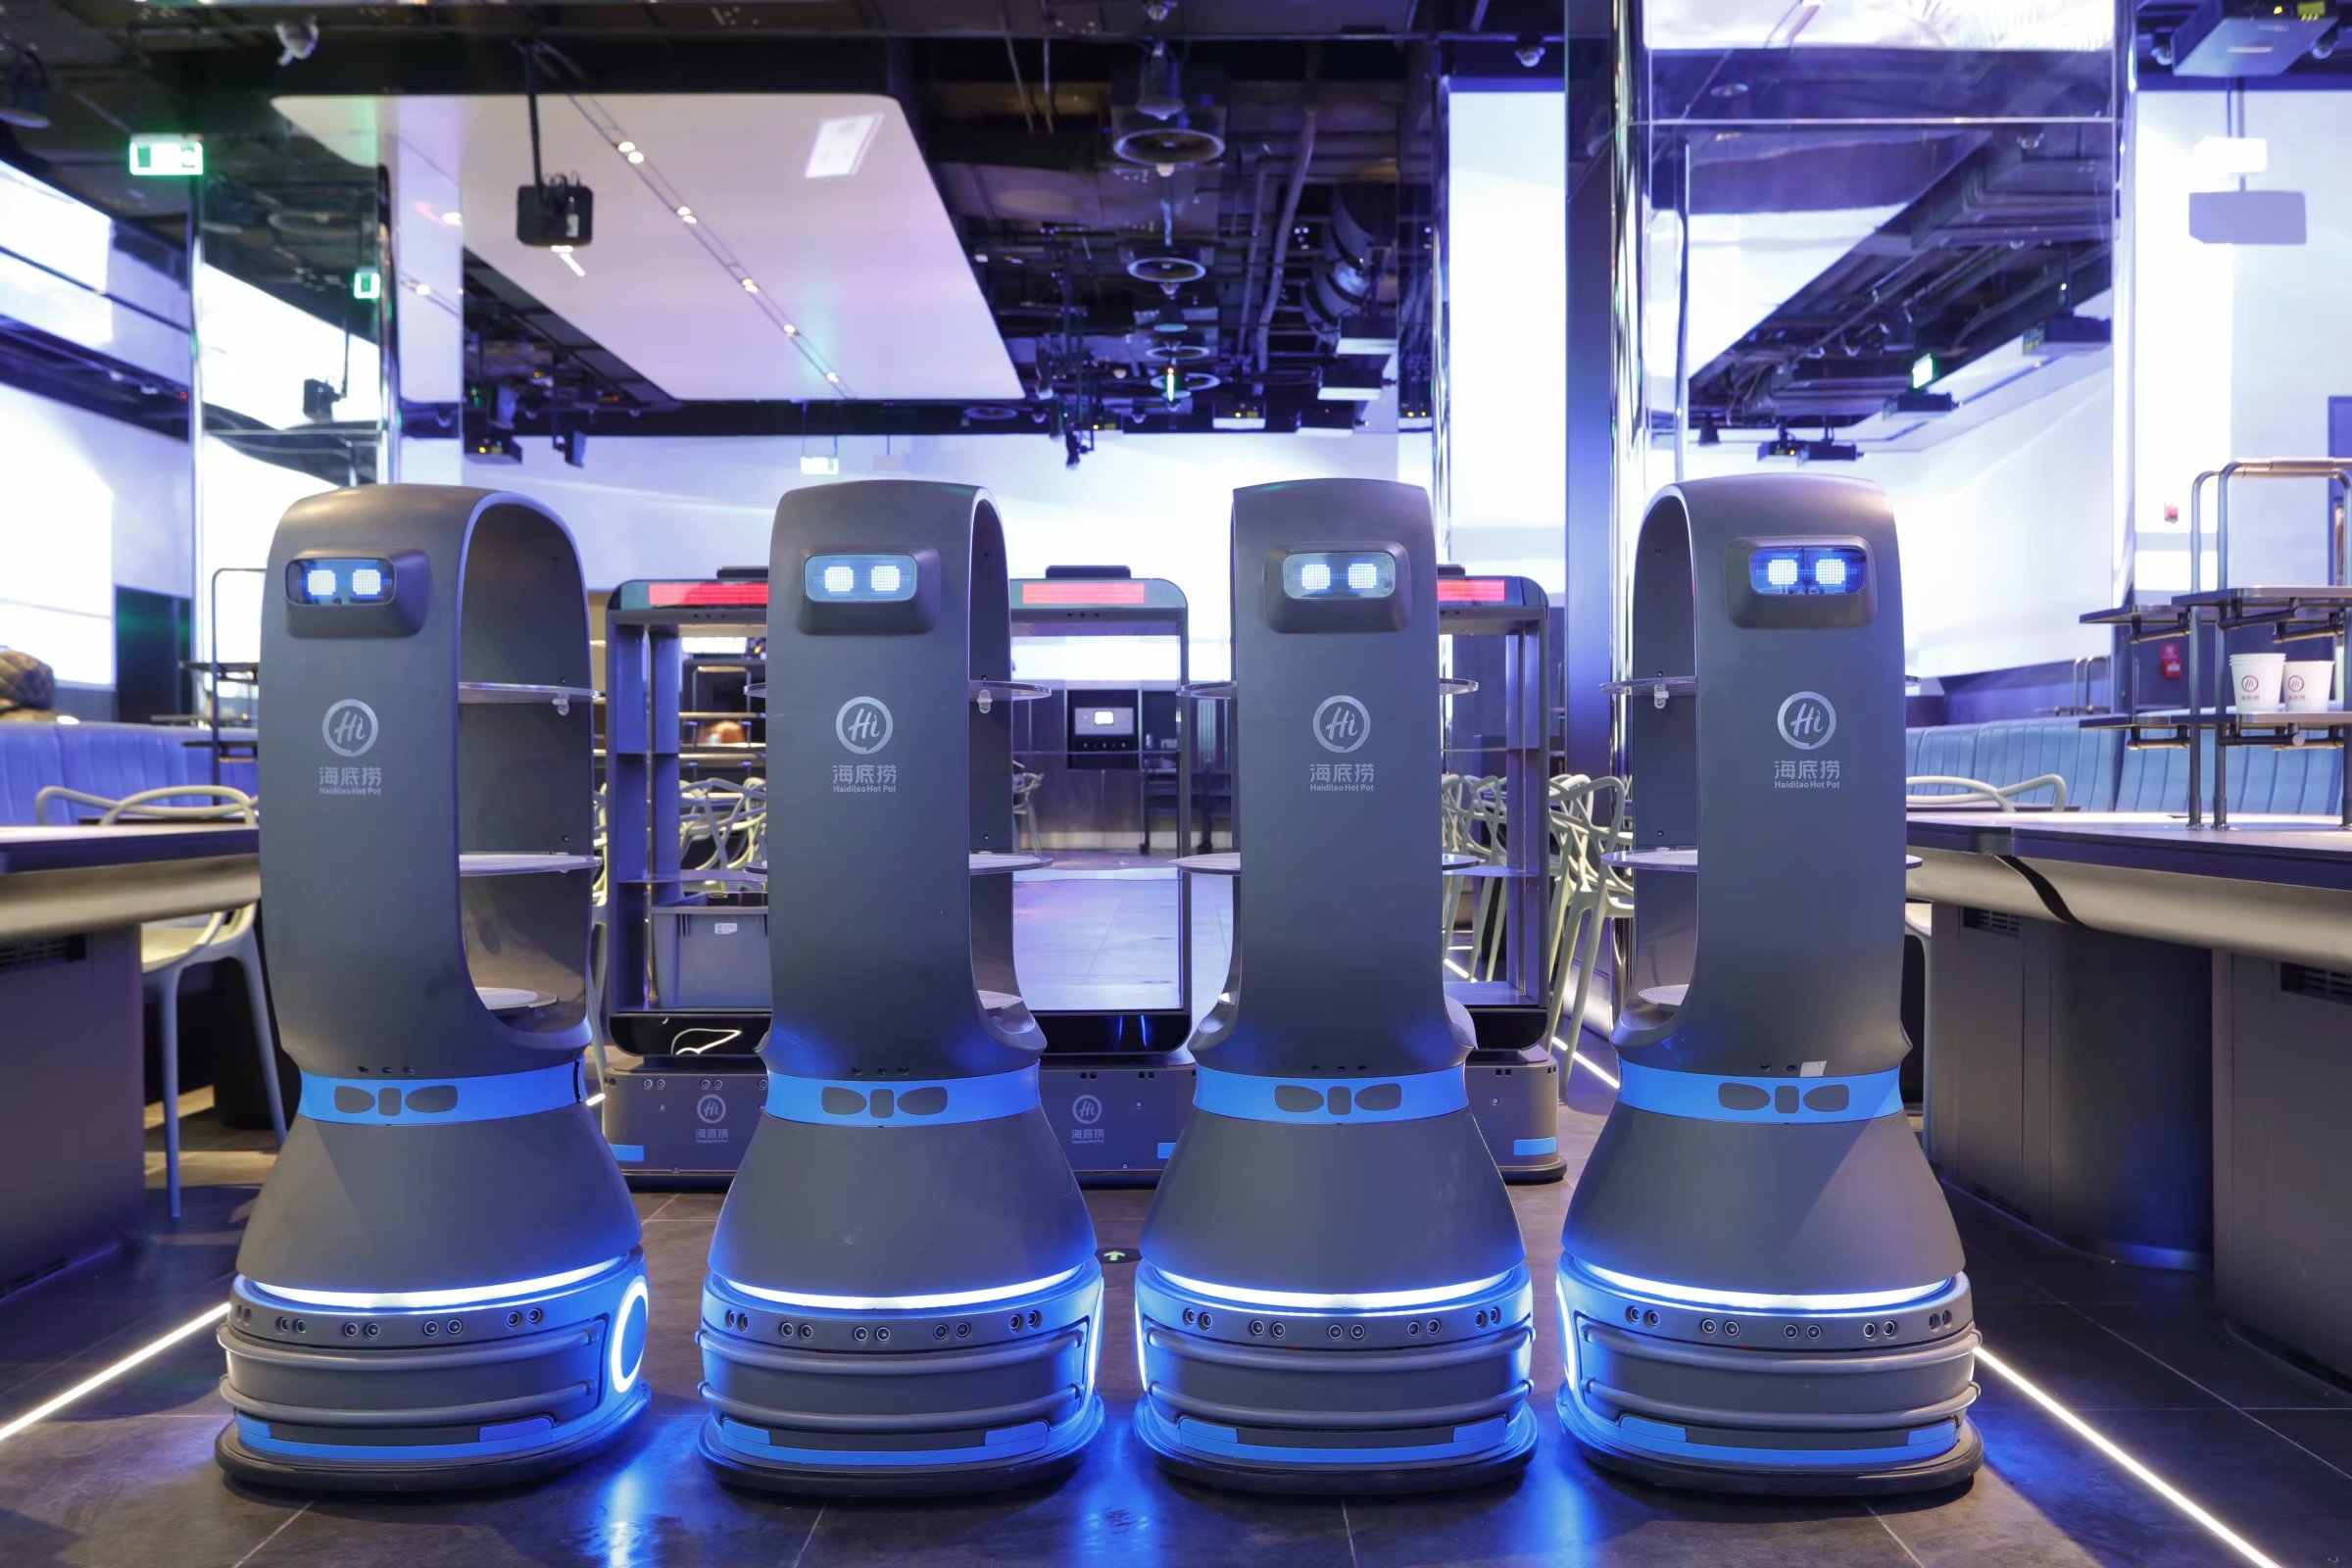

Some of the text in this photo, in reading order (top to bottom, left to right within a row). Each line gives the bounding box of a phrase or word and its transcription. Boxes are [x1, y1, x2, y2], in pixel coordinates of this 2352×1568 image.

[318, 766, 381, 786] 海底捞
[832, 764, 897, 784] 海底捞
[1310, 763, 1374, 783] 海底捞
[1774, 760, 1840, 780] 海底捞
